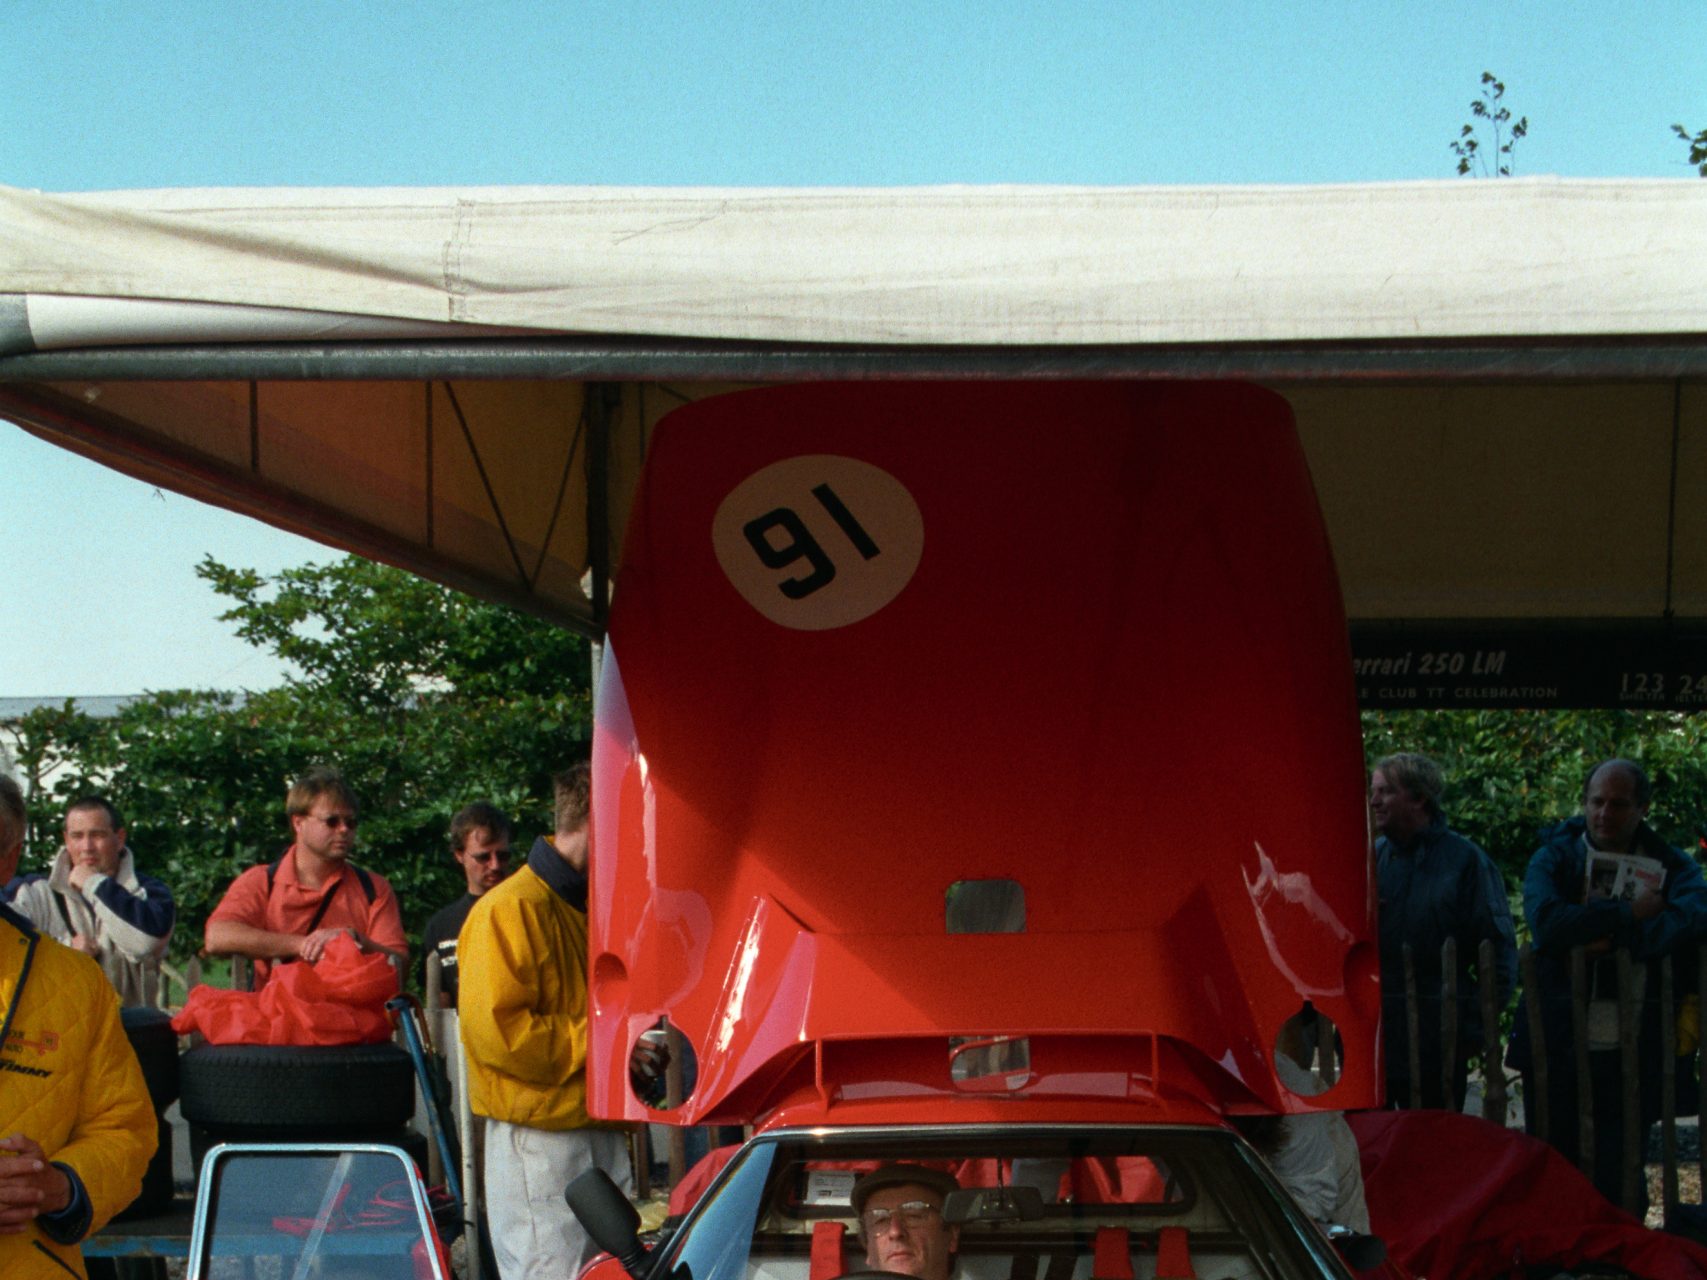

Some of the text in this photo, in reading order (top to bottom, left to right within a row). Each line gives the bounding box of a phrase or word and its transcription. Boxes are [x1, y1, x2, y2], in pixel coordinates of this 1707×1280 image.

[743, 483, 880, 600] 16
[1352, 650, 1506, 675] errari 250 LM
[1379, 687, 1417, 698] CLUB
[1426, 687, 1446, 698] TT
[1455, 686, 1558, 699] CELEBRATION
[1621, 673, 1664, 693] 123
